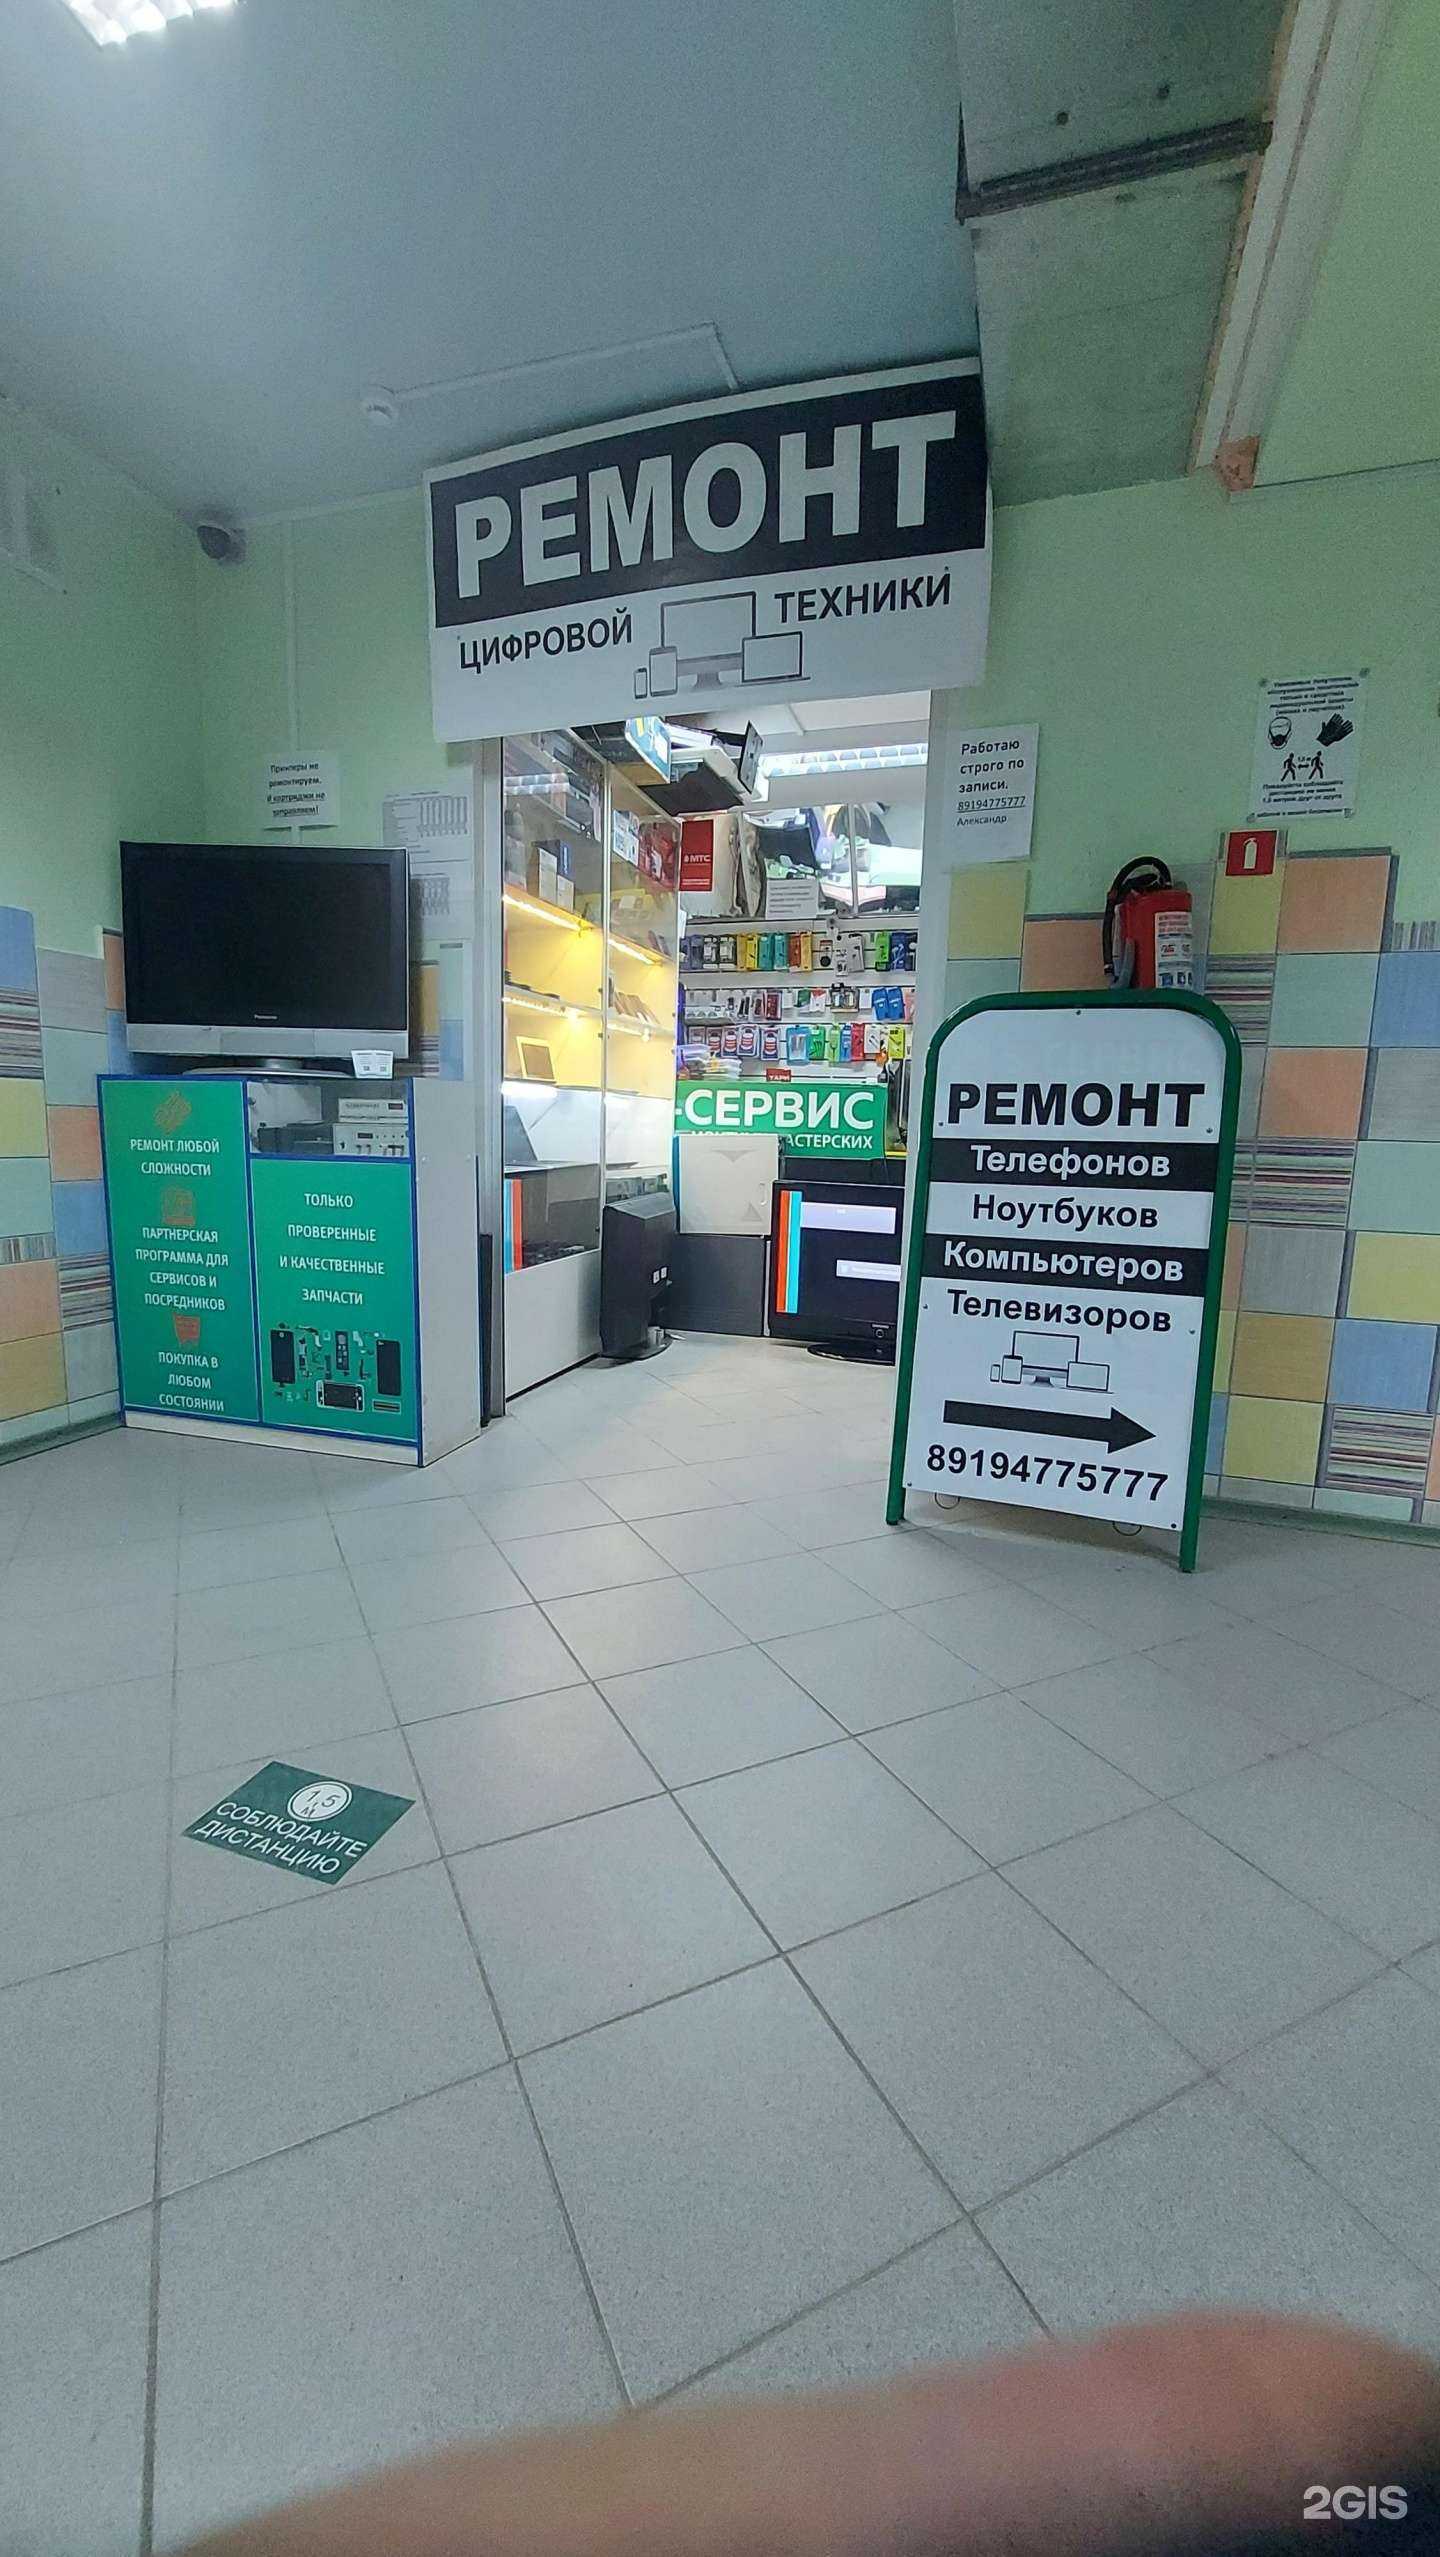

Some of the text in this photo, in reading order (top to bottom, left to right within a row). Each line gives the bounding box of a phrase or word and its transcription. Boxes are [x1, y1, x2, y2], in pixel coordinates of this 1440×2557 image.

[455, 411, 956, 599] РЕМОНТ
[775, 572, 951, 624] ТЕХНИКИ
[460, 606, 633, 674] ЦИФРОВОЙ
[961, 740, 1020, 755] Работаю
[960, 759, 1024, 776] строго по
[958, 780, 1008, 793] записи.
[958, 796, 1026, 812] 89194775777
[957, 815, 1007, 827] Александр
[948, 1083, 1205, 1128] РЕМОНТ
[130, 1138, 220, 1153] РЕМОНТ ЛЮБОЙ
[781, 1133, 873, 1149] АСТЕРСКИХ
[141, 1163, 211, 1177] СЛОЖНОСТИ
[970, 1144, 1171, 1180] Телефонов
[304, 1193, 353, 1208] ТОЛЬКО
[972, 1194, 1159, 1231] Ноутбуков
[142, 1227, 218, 1243] ПАРТНЕРСКАЯ
[288, 1224, 377, 1242] ПРОВЕРЕННЫЕ
[136, 1248, 229, 1267] ПРОГРАММА ДЛЯ
[279, 1256, 385, 1275] И КАЧЕСТВЕННЫЕ
[943, 1241, 1184, 1286] Компьютеров
[149, 1271, 217, 1288] СЕРВИСОВ И
[144, 1292, 225, 1311] ПОСРЕДНИКОВ
[302, 1288, 363, 1305] ЗАПЧАСТИ
[947, 1288, 1172, 1334] Телевизоров
[158, 1351, 219, 1368] ПОКУПКА В
[168, 1373, 211, 1389] ЛЮБОМ
[159, 1393, 224, 1412] СОСТОЯНИИ
[927, 1444, 1169, 1501] 89194775777
[216, 1801, 367, 1859] СОБЛЮДАЙТЕ
[194, 1820, 340, 1874] ДИСТАНЦИЮ
